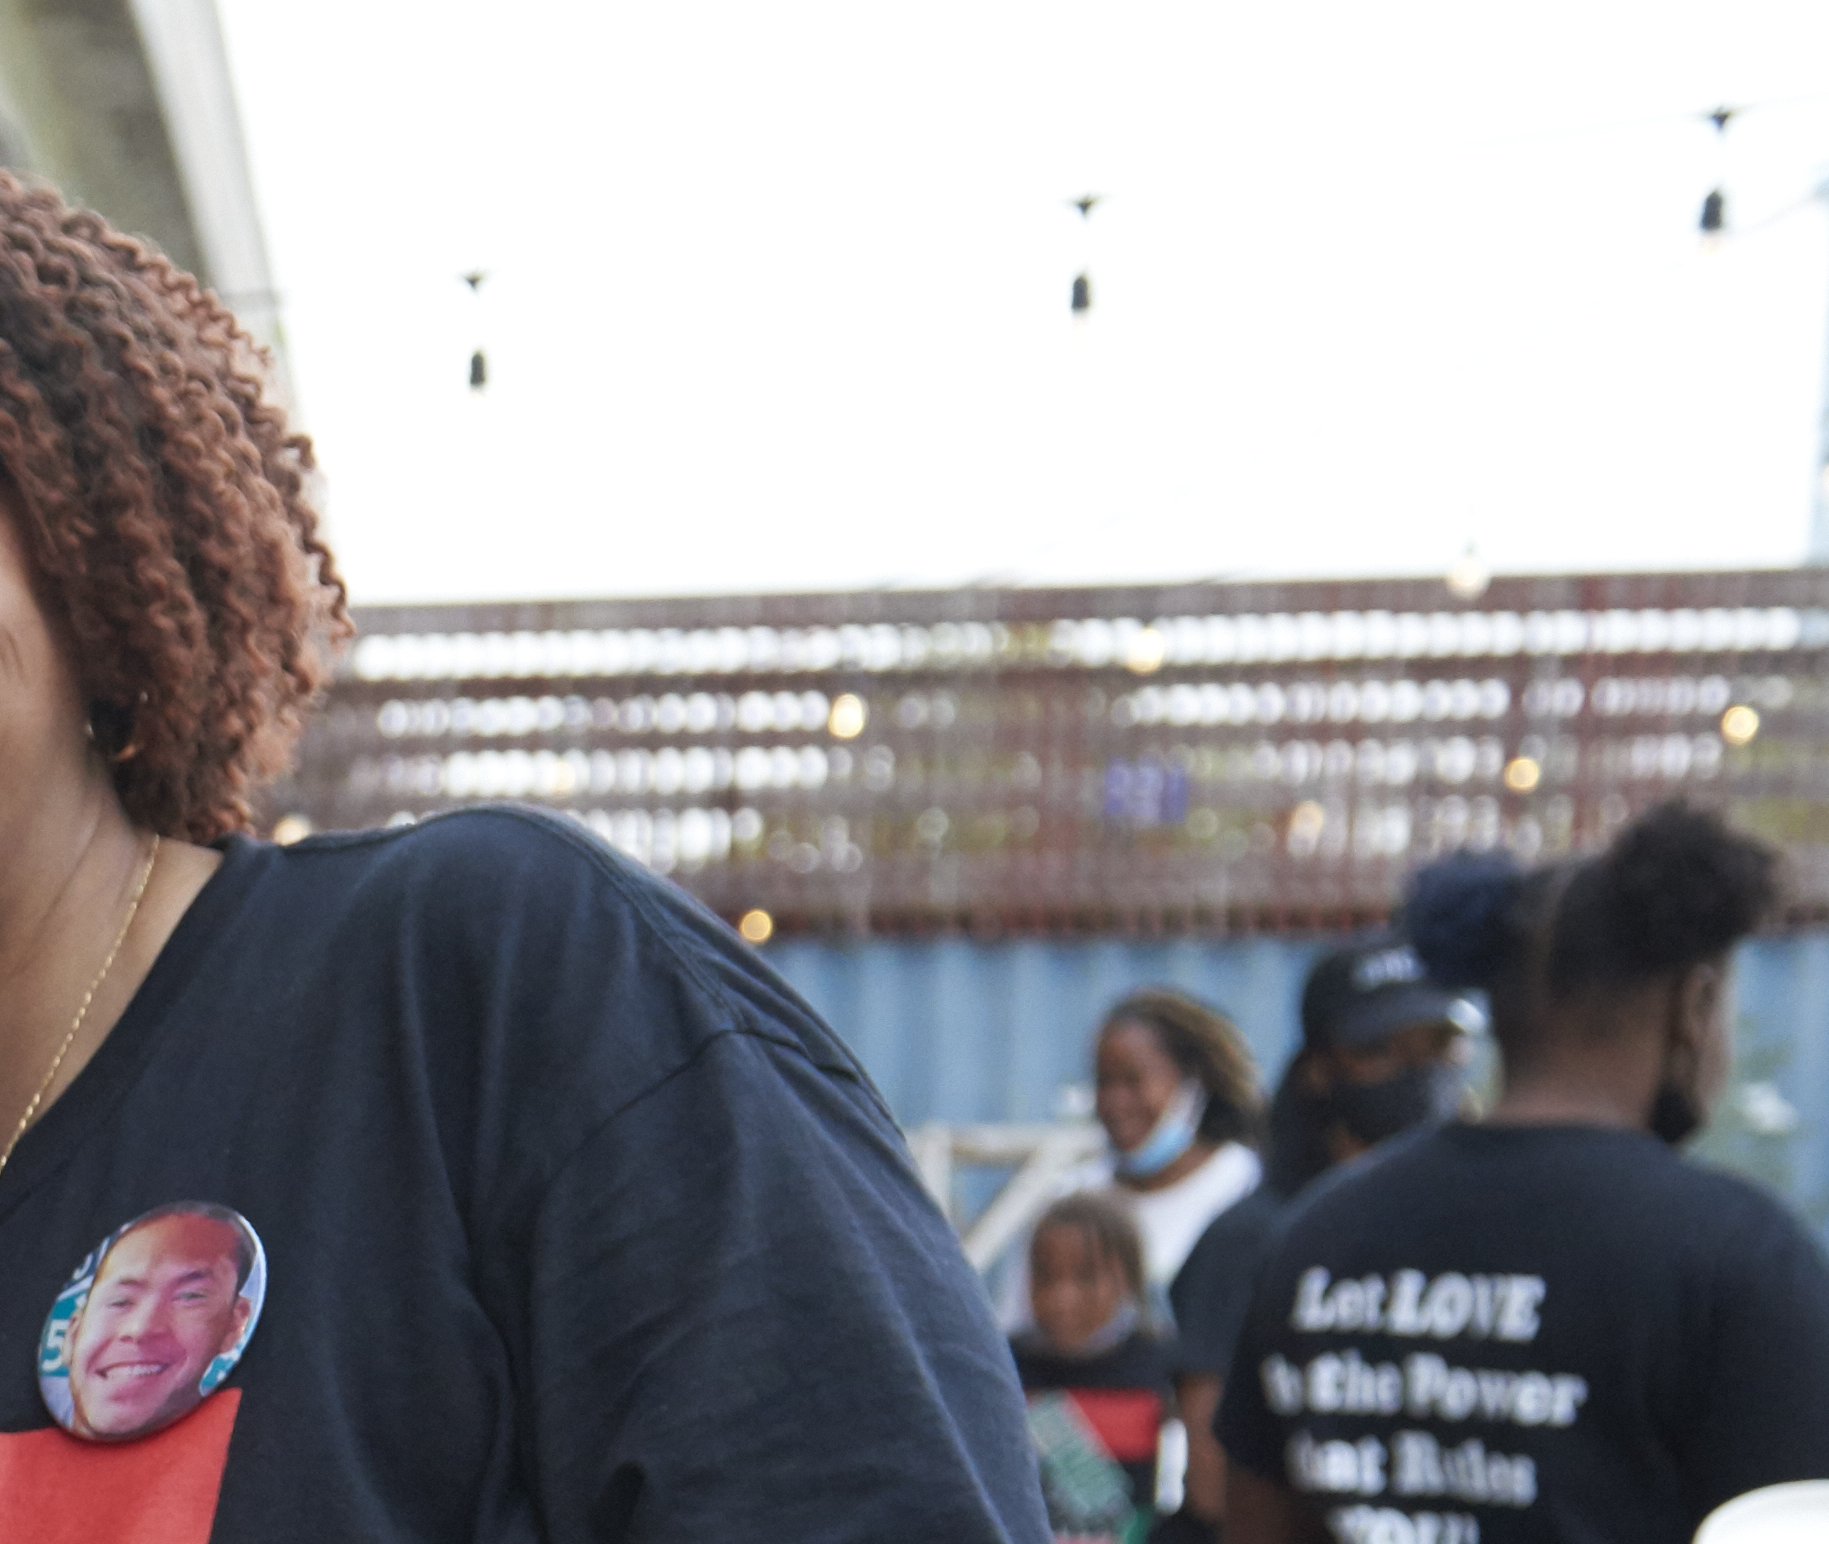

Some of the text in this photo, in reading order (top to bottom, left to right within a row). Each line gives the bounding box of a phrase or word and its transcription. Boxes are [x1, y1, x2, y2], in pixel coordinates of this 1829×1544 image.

[1290, 1265, 1547, 1342] Let LOVE
[1403, 1352, 1589, 1428] Power
